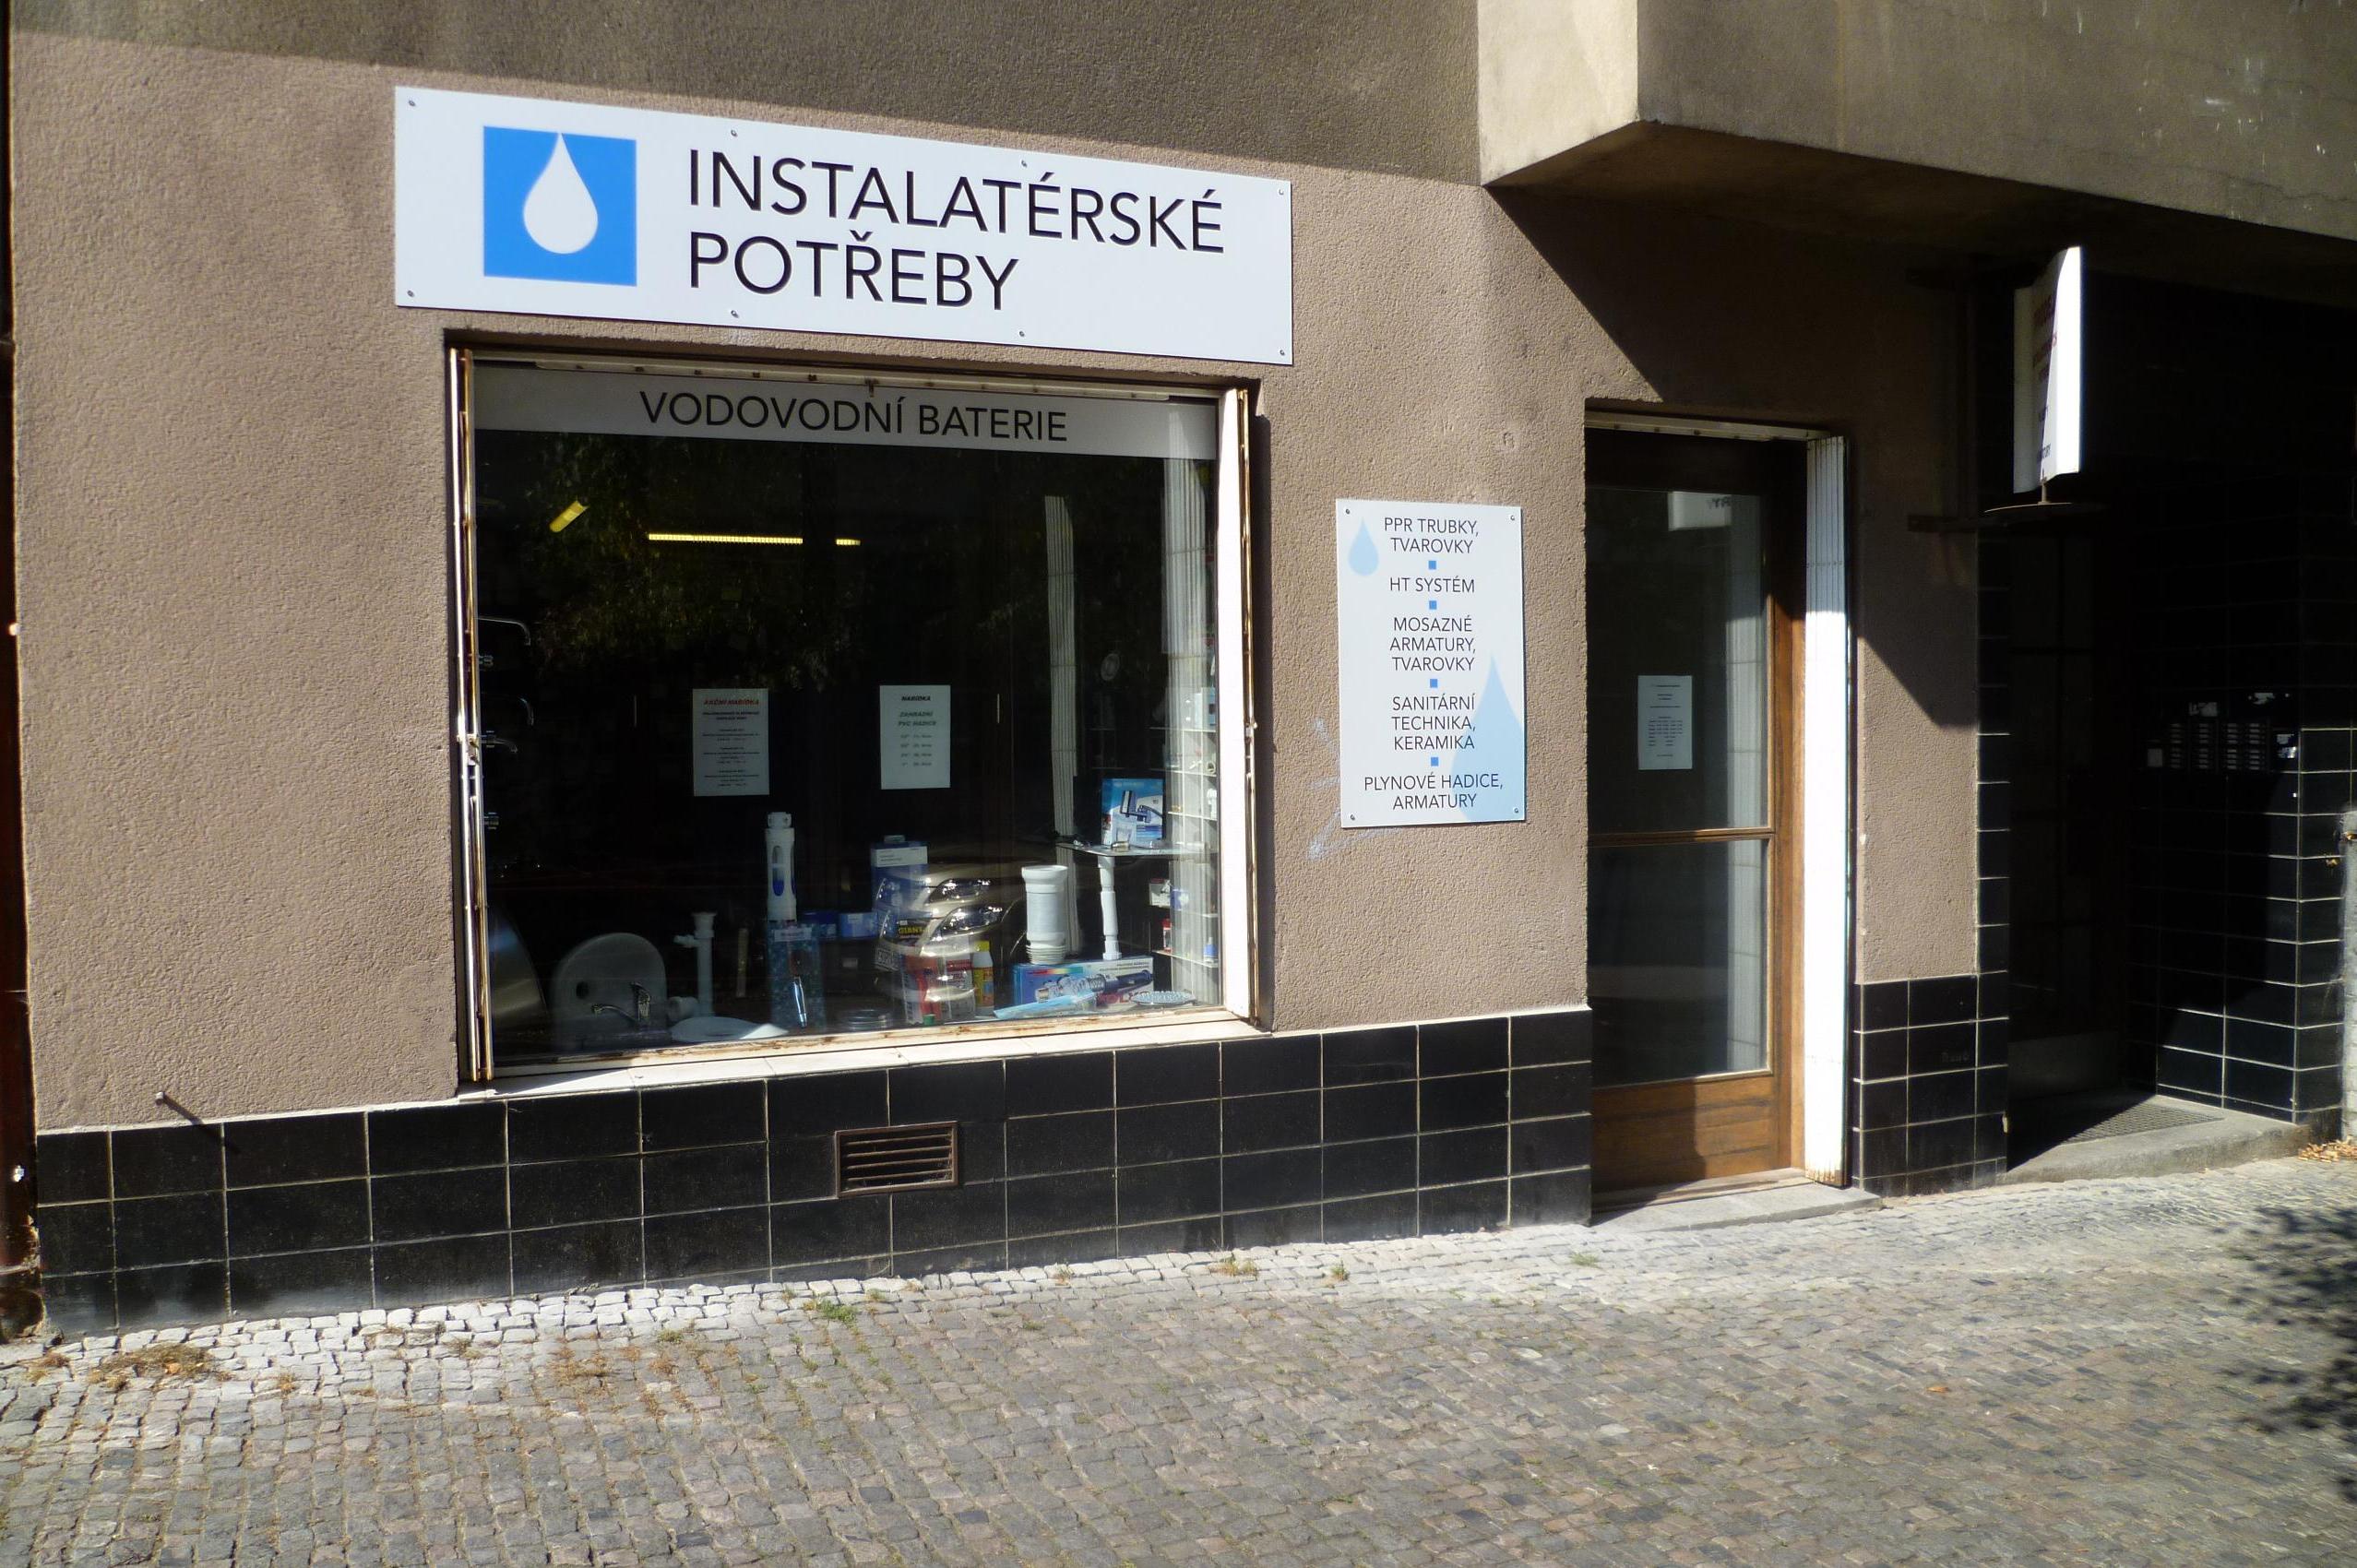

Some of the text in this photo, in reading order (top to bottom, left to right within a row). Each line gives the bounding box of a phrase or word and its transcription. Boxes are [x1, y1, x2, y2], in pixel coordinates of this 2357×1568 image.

[690, 148, 1224, 254] INSTALATÉRSKÉ
[690, 230, 1019, 311] POTŘEBY
[639, 389, 1068, 442] VODOVODNÍ BATERIE
[1384, 517, 1479, 538] PPR TRUBKY,
[1390, 537, 1473, 554] TVAROVKY
[1389, 575, 1475, 593] HT SYSTÉM
[1394, 614, 1472, 633] MOSAZNÉ
[1389, 636, 1476, 654] ARMATURY,
[1391, 657, 1475, 671] TVAROVKY
[1392, 693, 1476, 711] SANITÁRNÍ
[1391, 716, 1476, 733] TECHNIKA,
[1394, 735, 1475, 751] KERAMIKA
[1364, 772, 1504, 791] PLYNOVÉ HADICE,
[1392, 793, 1477, 811] ARMATURY
